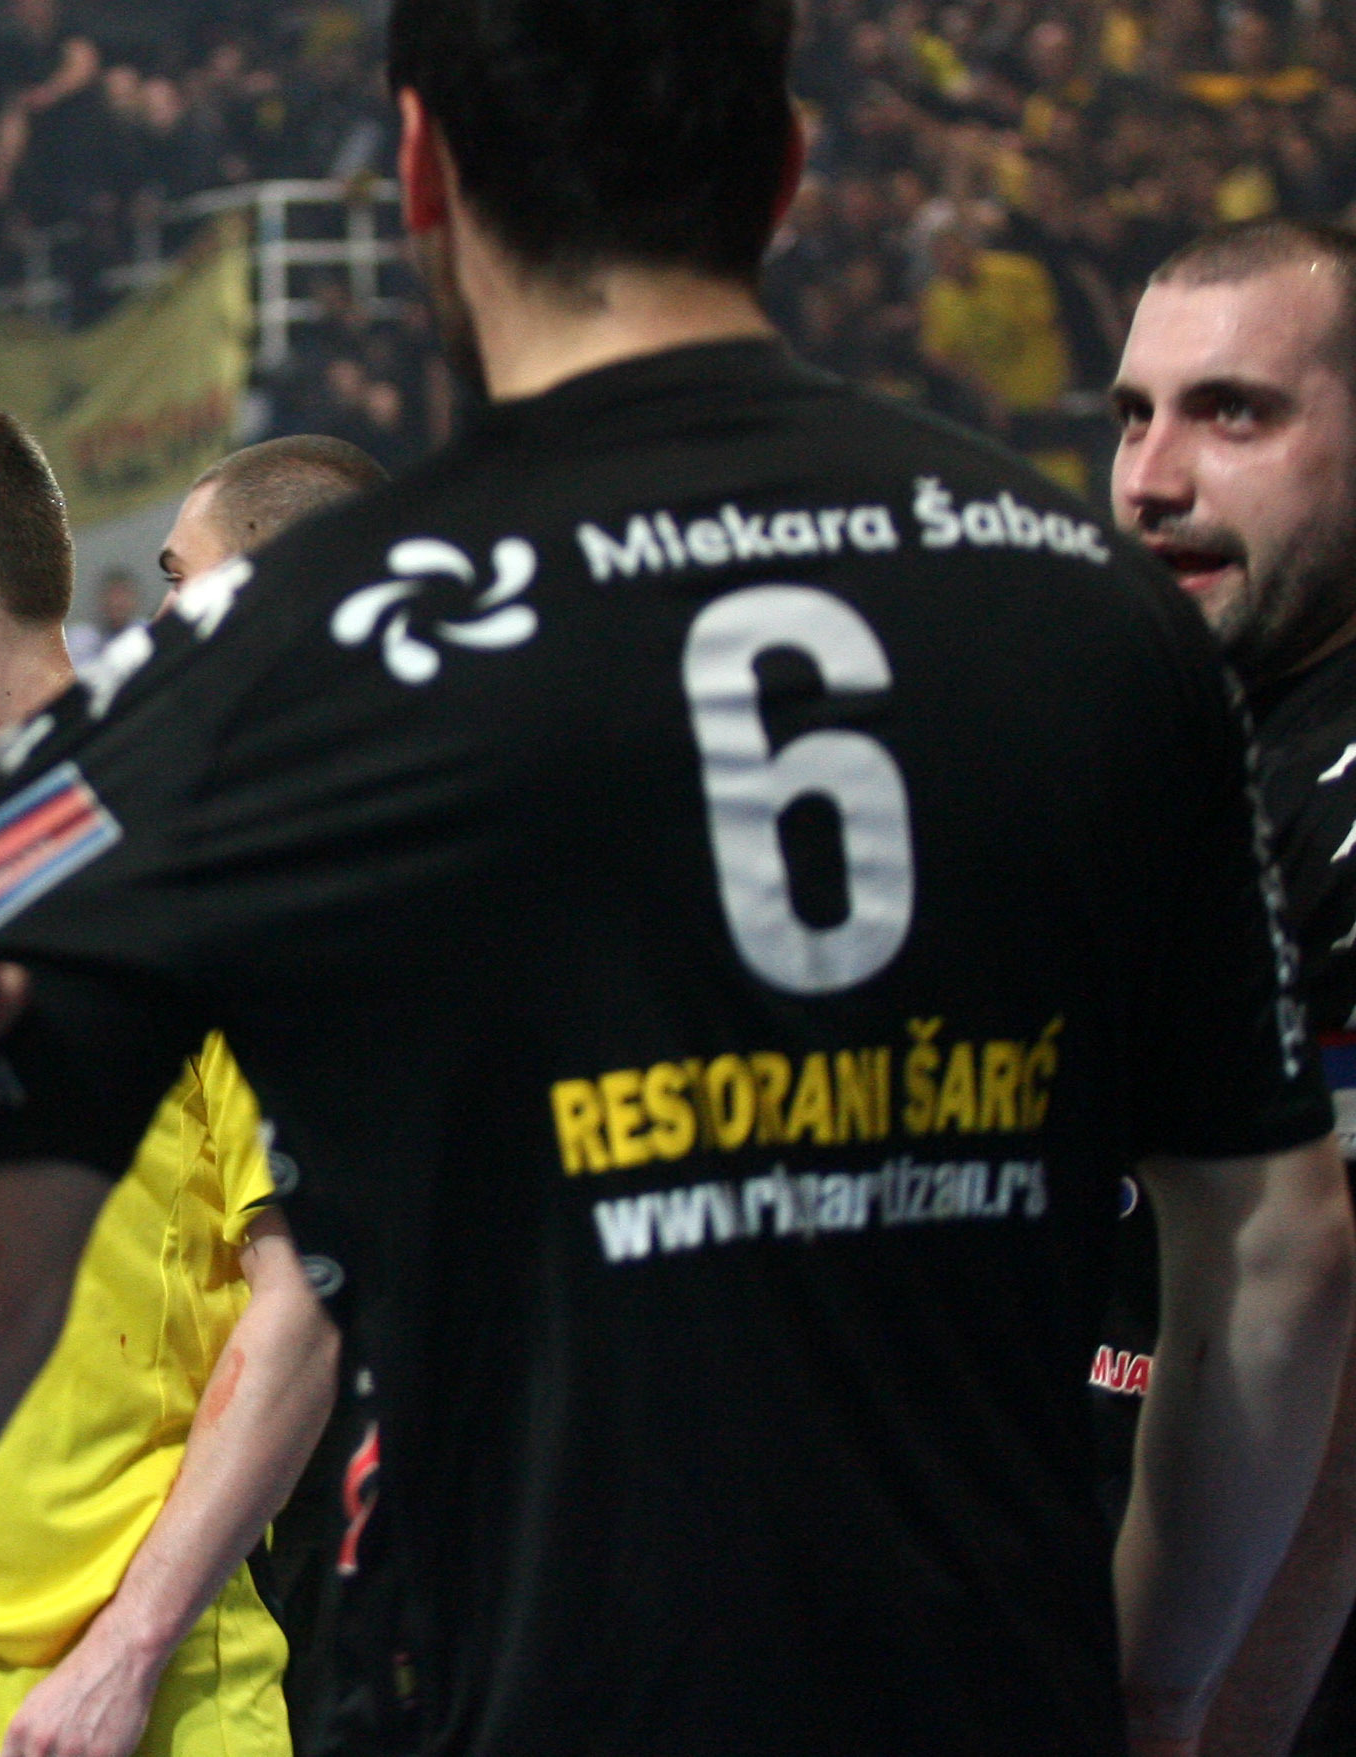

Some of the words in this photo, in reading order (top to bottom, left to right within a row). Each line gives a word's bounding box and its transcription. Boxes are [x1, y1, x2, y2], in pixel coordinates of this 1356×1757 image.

[577, 503, 897, 582] Mlekara
[913, 475, 1110, 566] Šabac
[682, 584, 915, 994] 6
[550, 1046, 892, 1176] RESORANI
[903, 1016, 1064, 1135] ŠARĆ
